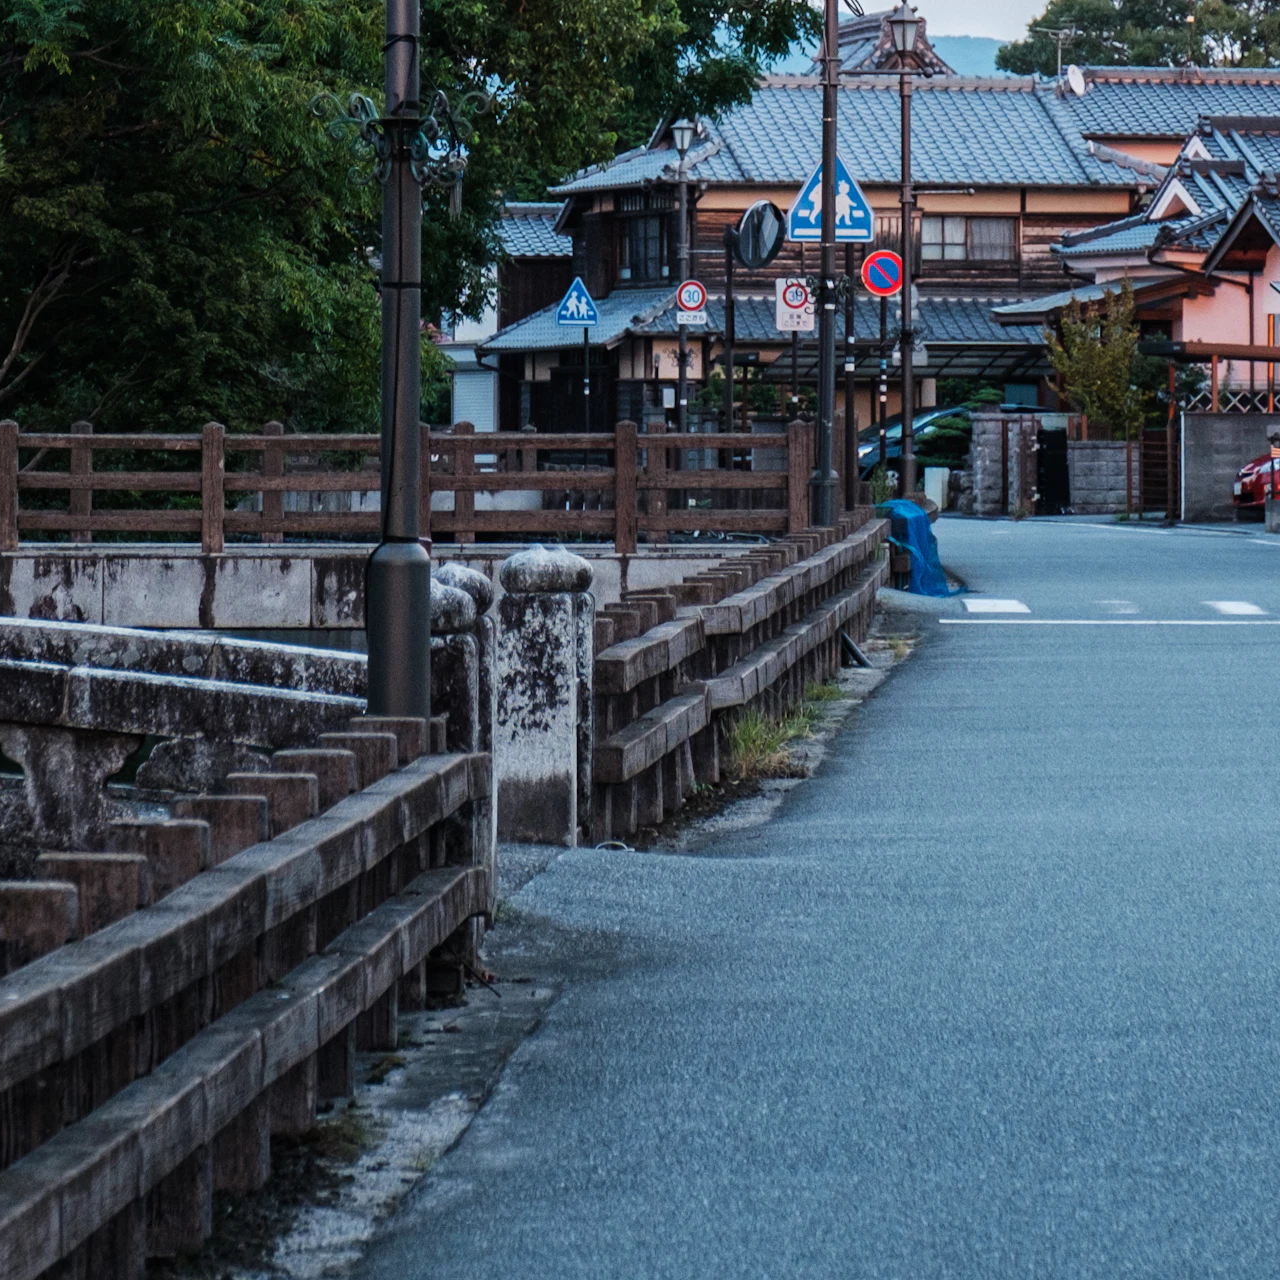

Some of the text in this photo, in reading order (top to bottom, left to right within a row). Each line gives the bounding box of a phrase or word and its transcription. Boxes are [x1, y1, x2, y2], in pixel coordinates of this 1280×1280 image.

[684, 289, 700, 303] 30
[788, 290, 803, 302] 30
[679, 314, 705, 322] ここから
